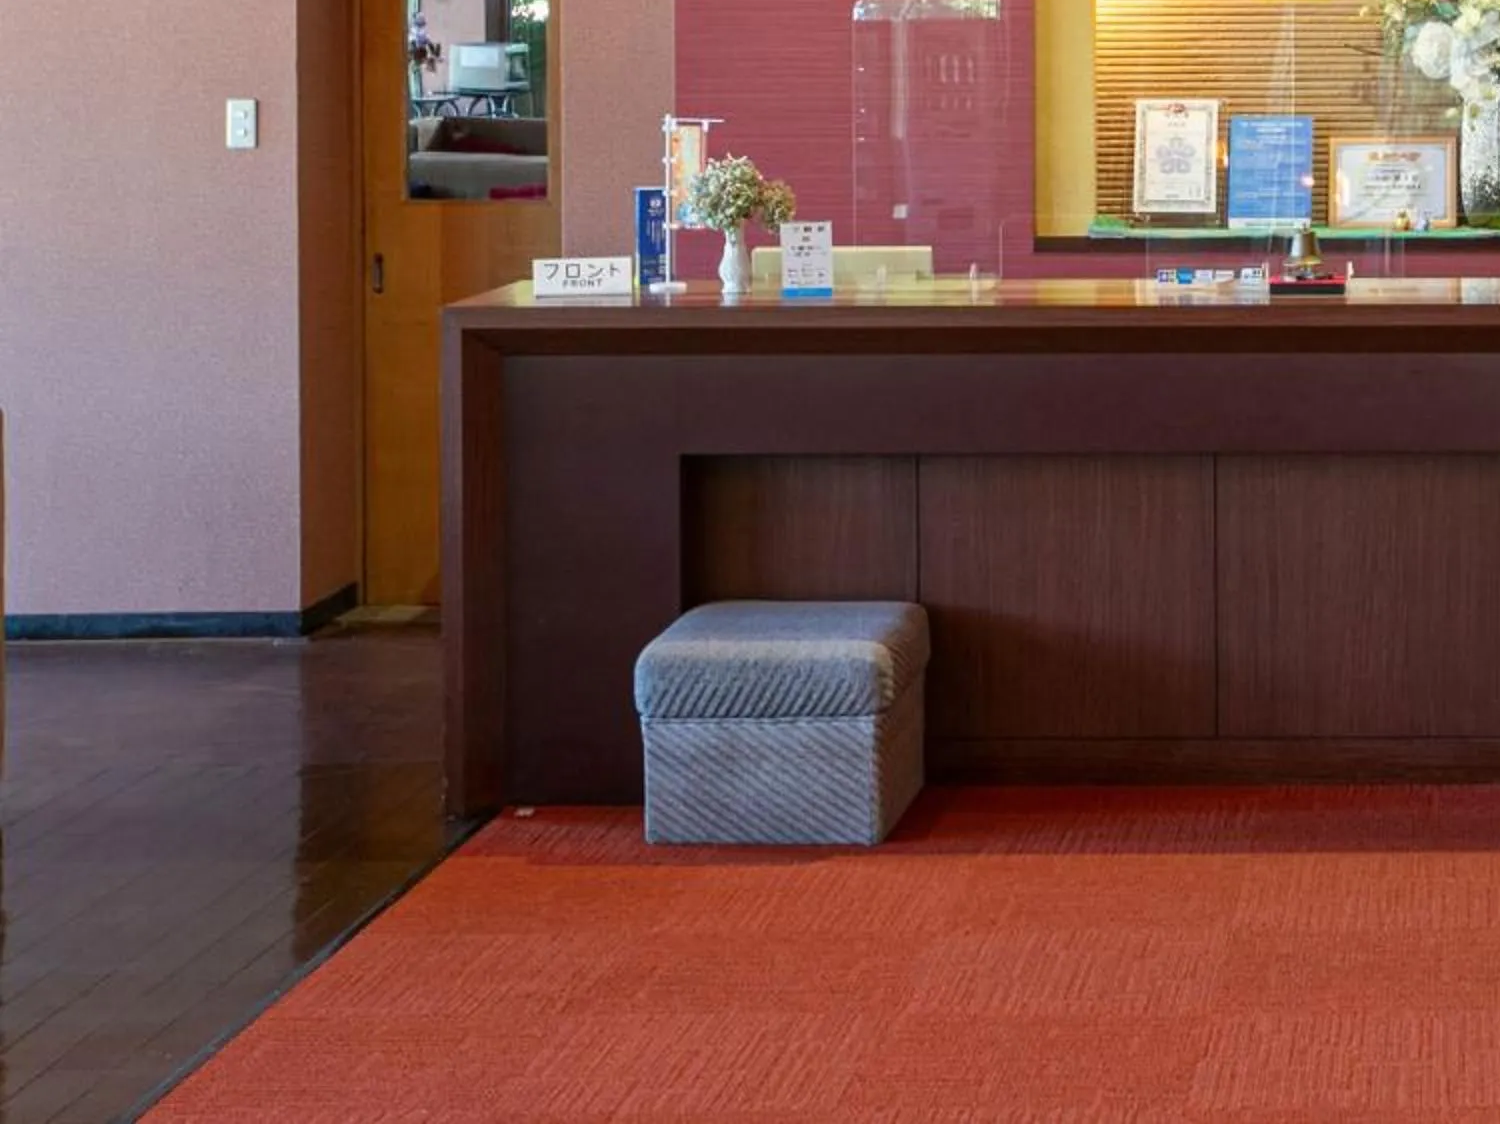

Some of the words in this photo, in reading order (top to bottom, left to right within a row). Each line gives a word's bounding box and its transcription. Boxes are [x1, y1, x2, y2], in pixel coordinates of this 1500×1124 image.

[543, 262, 620, 280] フロント
[562, 278, 603, 288] FRONT
